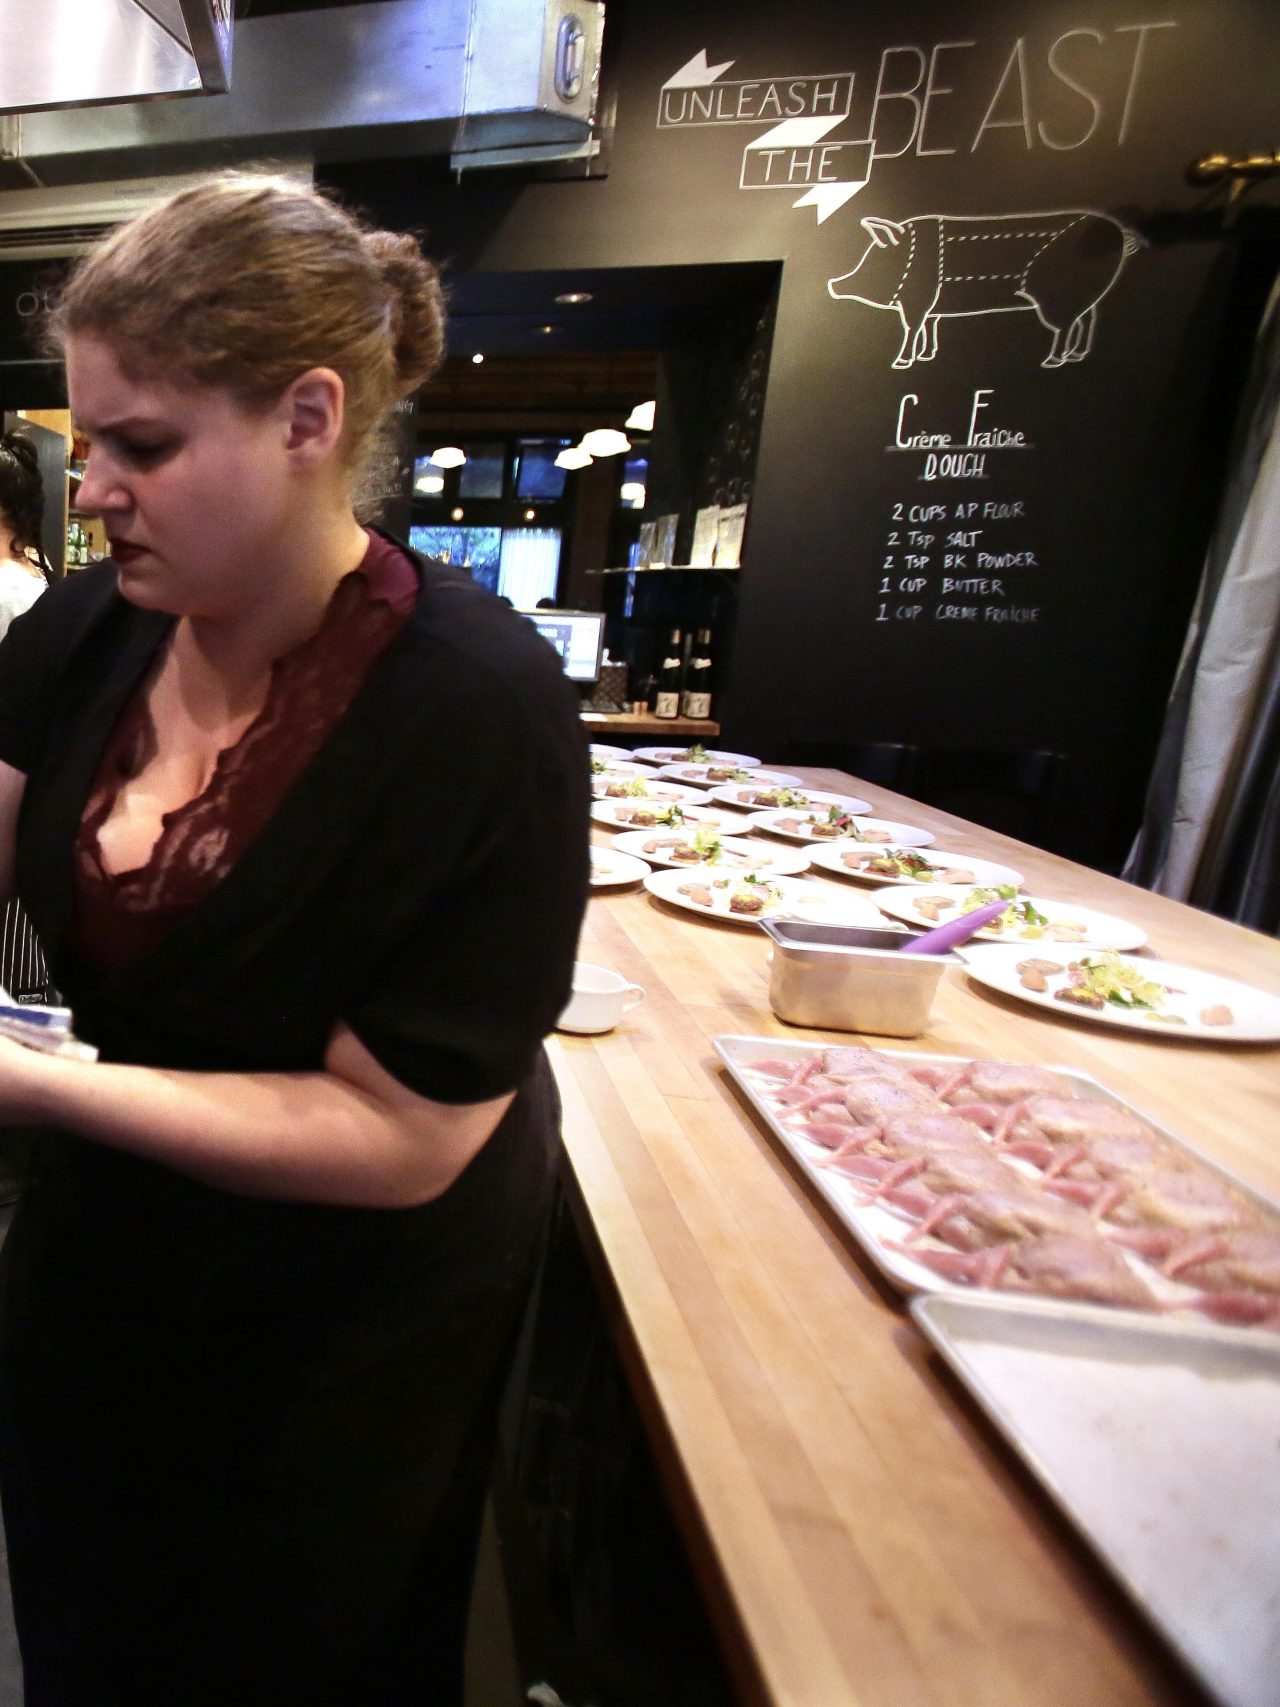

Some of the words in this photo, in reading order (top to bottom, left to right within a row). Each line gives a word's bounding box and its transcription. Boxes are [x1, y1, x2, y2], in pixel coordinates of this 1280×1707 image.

[869, 21, 1177, 160] BEAST
[664, 80, 838, 124] UNLEASH
[758, 145, 843, 182] THE
[924, 453, 986, 481] DOUGH
[892, 503, 904, 521] 2
[909, 505, 947, 522] CUPS
[983, 502, 1025, 519] FLOUR
[887, 532, 900, 546] 2
[944, 530, 983, 548] SALT
[883, 555, 895, 569] 2
[944, 554, 967, 569] BK
[977, 552, 1039, 569] POWDER
[879, 577, 891, 593] 1
[899, 578, 927, 593] CUP
[942, 578, 1006, 596] BUTTER
[875, 603, 889, 621] 1
[896, 605, 923, 620] CUP
